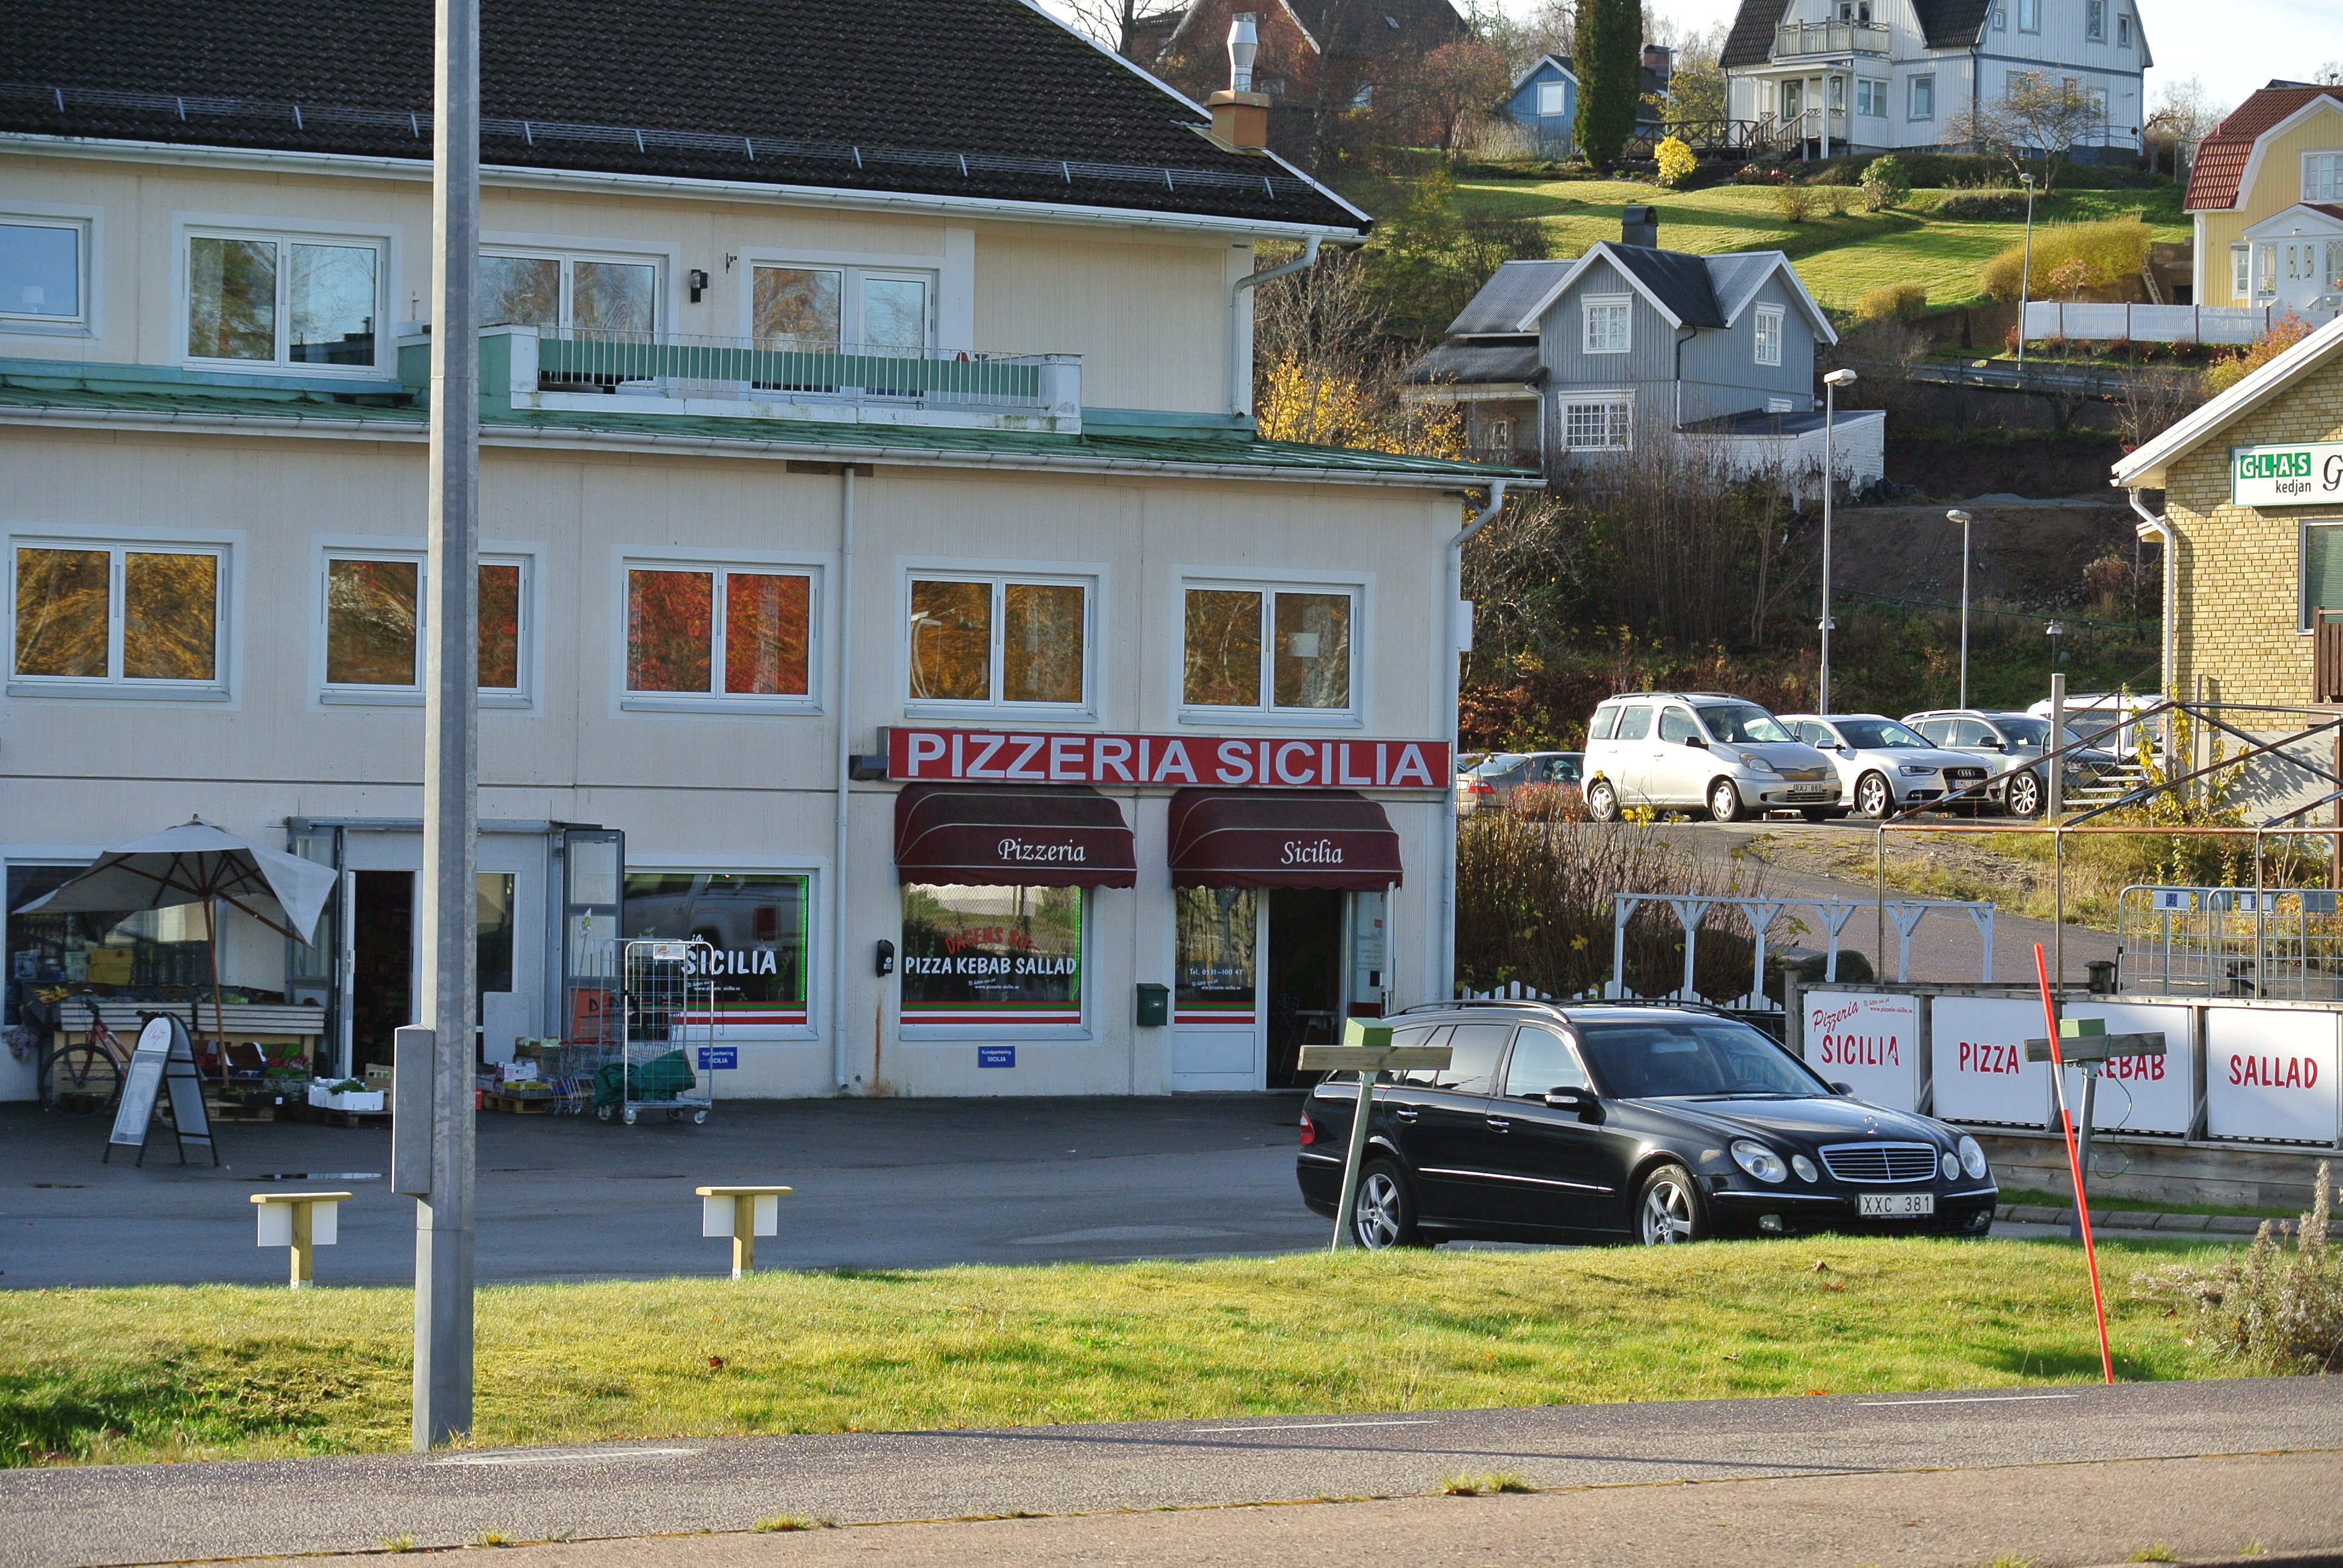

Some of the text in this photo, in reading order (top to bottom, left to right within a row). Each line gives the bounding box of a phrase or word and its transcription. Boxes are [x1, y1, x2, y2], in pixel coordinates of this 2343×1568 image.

[2241, 454, 2310, 478] GLAS
[2276, 479, 2312, 496] kedjan
[908, 733, 1434, 785] PIZZERIA SICILIA
[998, 838, 1086, 861] Pizzeria
[1281, 839, 1343, 864] Sicilia
[945, 926, 1003, 955] DAGENS
[681, 950, 776, 975] SICILIA
[905, 957, 1076, 975] PIZZA KEBAB SALLAD
[1812, 1001, 1860, 1033] Pizzeria
[1821, 1034, 1899, 1066] SICILIA
[1959, 1042, 2020, 1075] PIZZA
[2098, 1054, 2165, 1081] EBAB
[2229, 1054, 2318, 1089] SALLAD
[1864, 1196, 1929, 1213] XXC 381
